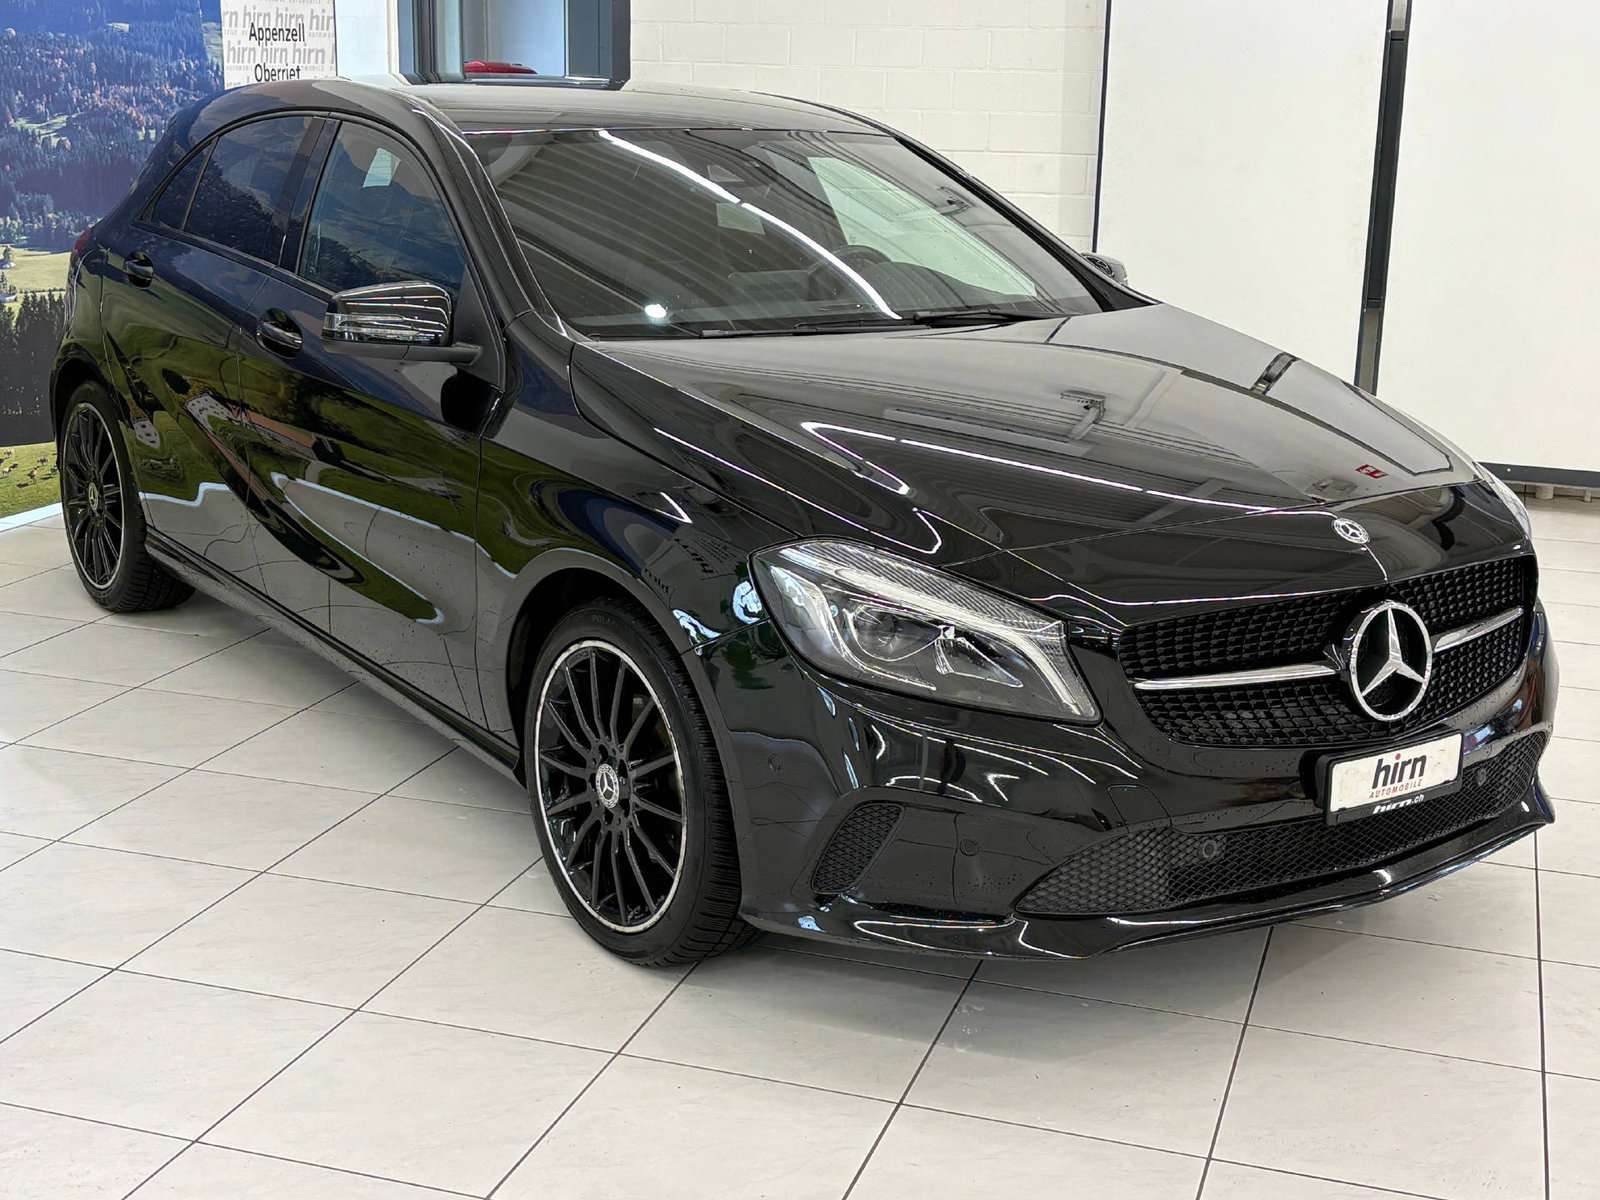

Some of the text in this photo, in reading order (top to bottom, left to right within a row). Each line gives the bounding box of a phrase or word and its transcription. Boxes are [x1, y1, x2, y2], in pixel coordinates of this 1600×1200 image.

[243, 5, 271, 28] hirn
[275, 7, 305, 28] hirn
[248, 22, 306, 47] Appenzell
[227, 40, 326, 65] hirn hirn hirn
[254, 62, 301, 82] Oberriet
[1371, 753, 1427, 789] hirn
[1369, 778, 1423, 800] AUTOMOBILE
